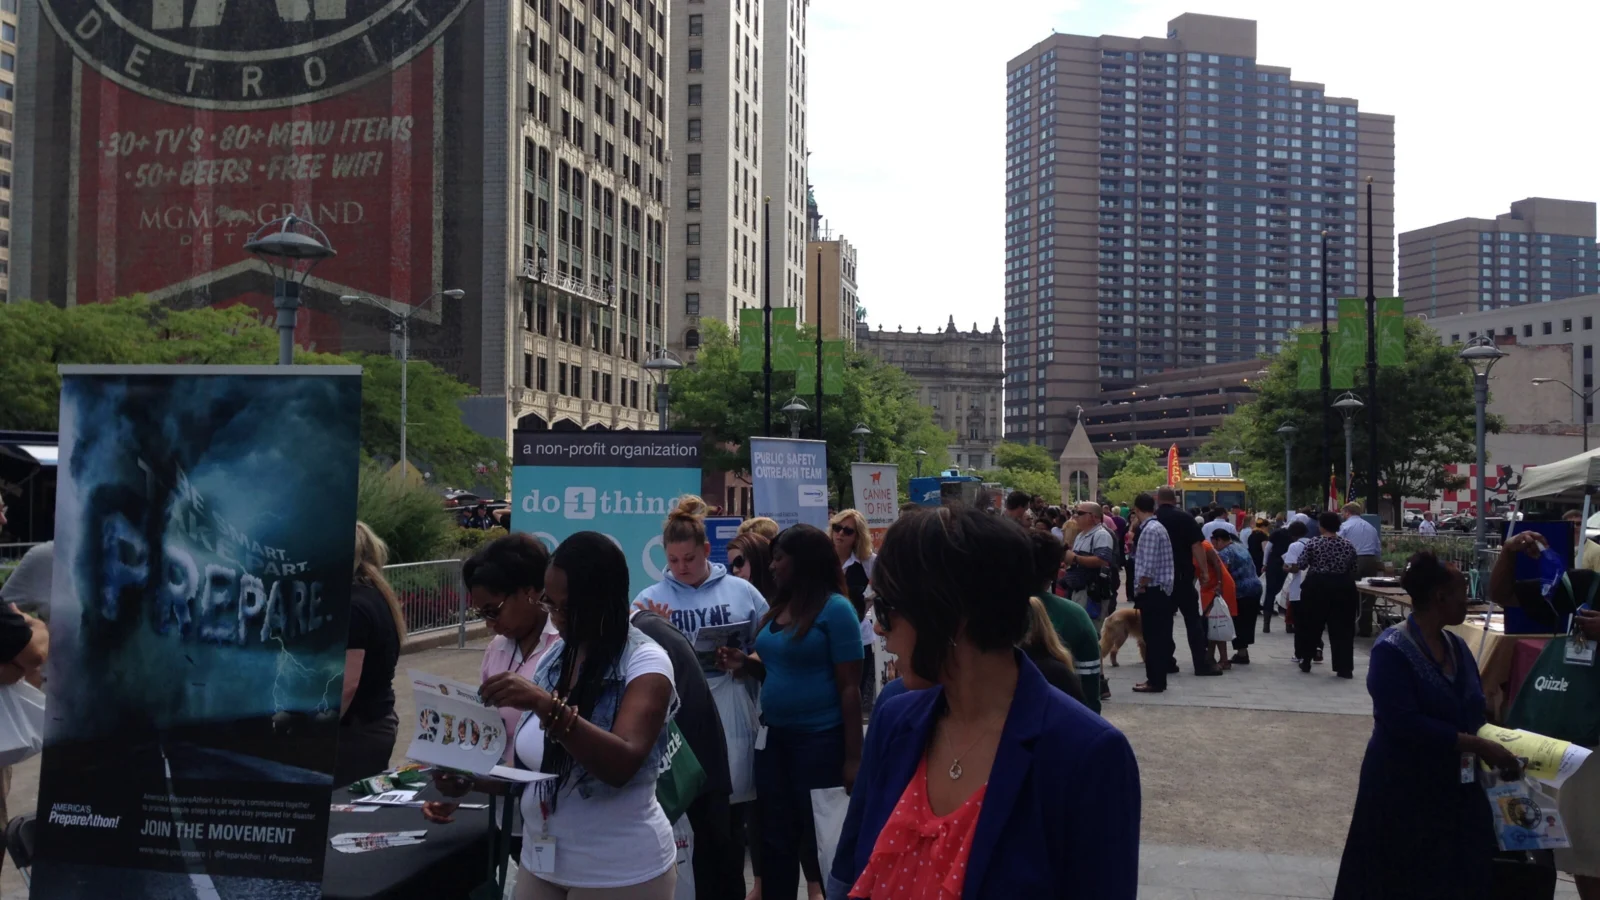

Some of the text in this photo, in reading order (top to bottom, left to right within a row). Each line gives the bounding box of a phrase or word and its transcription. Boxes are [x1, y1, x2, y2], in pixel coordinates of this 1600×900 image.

[75, 6, 429, 98] DETROIT
[155, 124, 204, 154] TV'S
[220, 125, 265, 152] 80+
[267, 119, 333, 148] MENU
[341, 115, 414, 143] ITEMS
[180, 159, 251, 186] BEERS
[266, 153, 326, 180] FREE
[332, 151, 384, 178] WIFI
[138, 205, 210, 230] MGM
[523, 442, 697, 459] a non-profit organization
[754, 452, 816, 466] PUBLIC SAFETY
[755, 467, 822, 479] OUTREACH TEAM
[522, 489, 560, 513] do
[863, 488, 892, 500] CANINE
[864, 503, 892, 515] TO FIVE
[1534, 675, 1569, 692] Quizzle
[51, 803, 91, 814] AMERICA'S
[49, 811, 120, 829] PrepareAthon!
[141, 819, 296, 844] JOIN THE MOVEMENT
